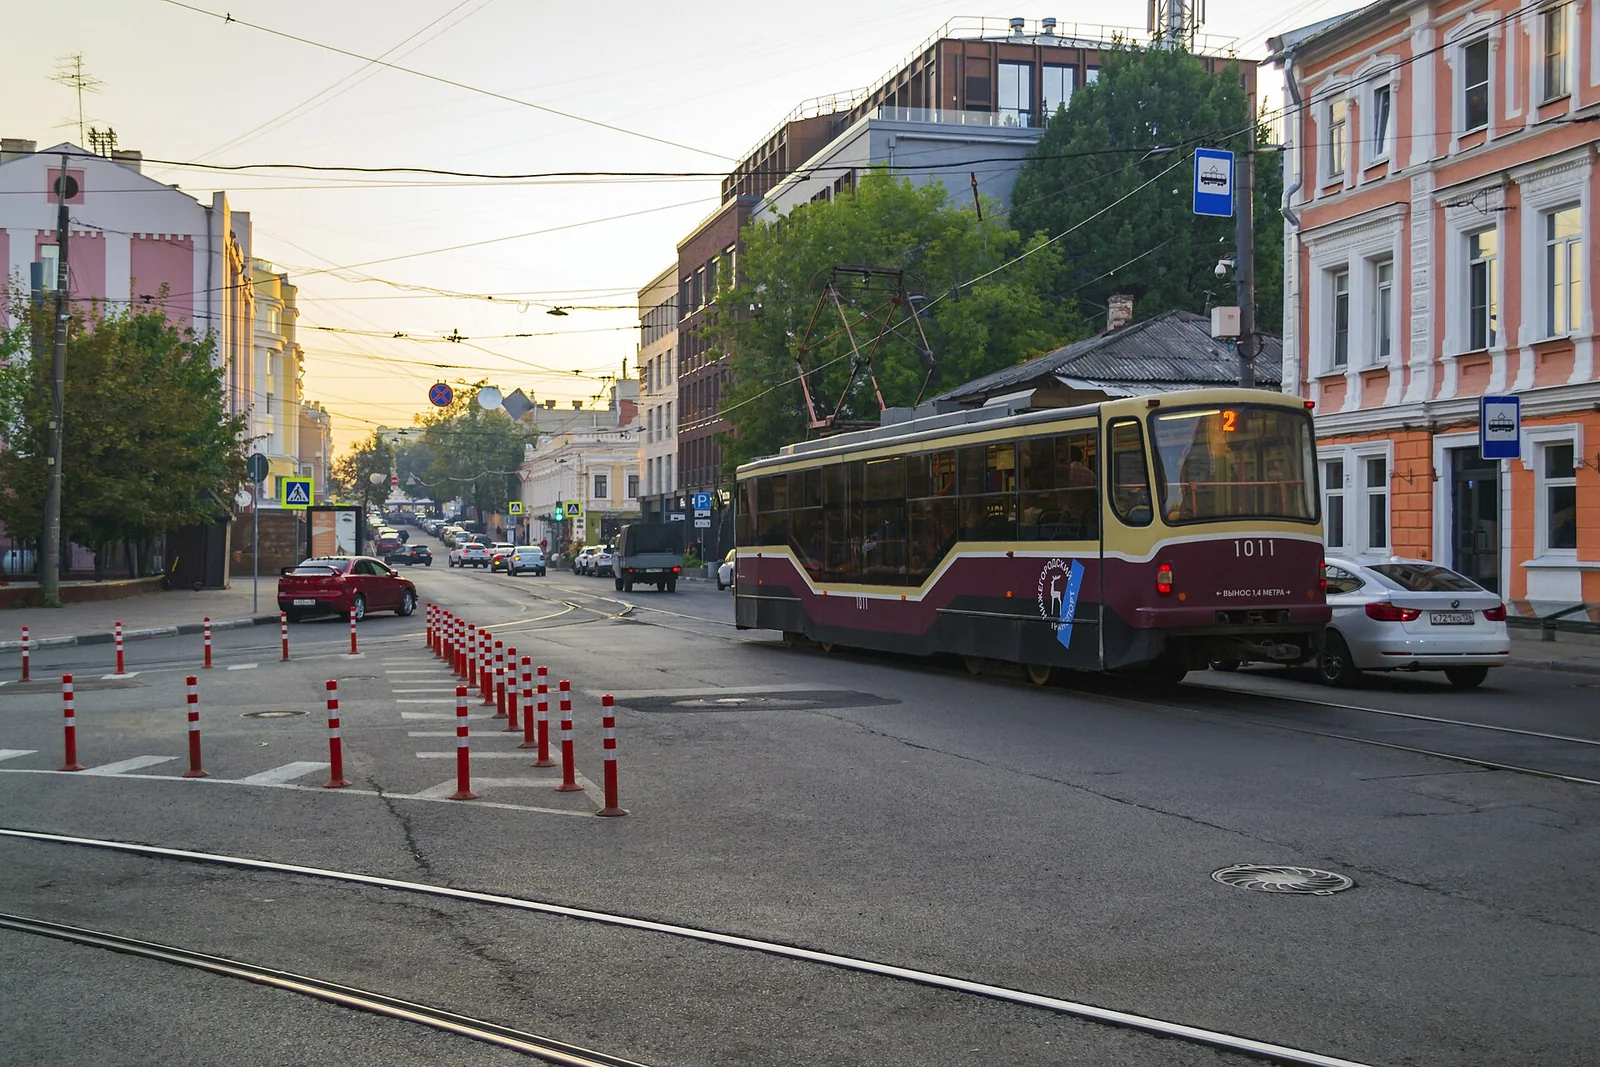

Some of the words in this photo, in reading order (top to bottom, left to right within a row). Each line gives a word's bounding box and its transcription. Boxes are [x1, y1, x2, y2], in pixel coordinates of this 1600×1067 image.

[1223, 410, 1235, 431] 2
[698, 495, 707, 508] P
[1234, 539, 1274, 557] 1011
[1037, 558, 1073, 620] НИЖЕГОРОДСКИЙ
[1223, 589, 1251, 597] ВЫНОС
[1252, 589, 1261, 597] 1,4
[1262, 588, 1285, 596] МЕТРА
[856, 597, 868, 610] 1011
